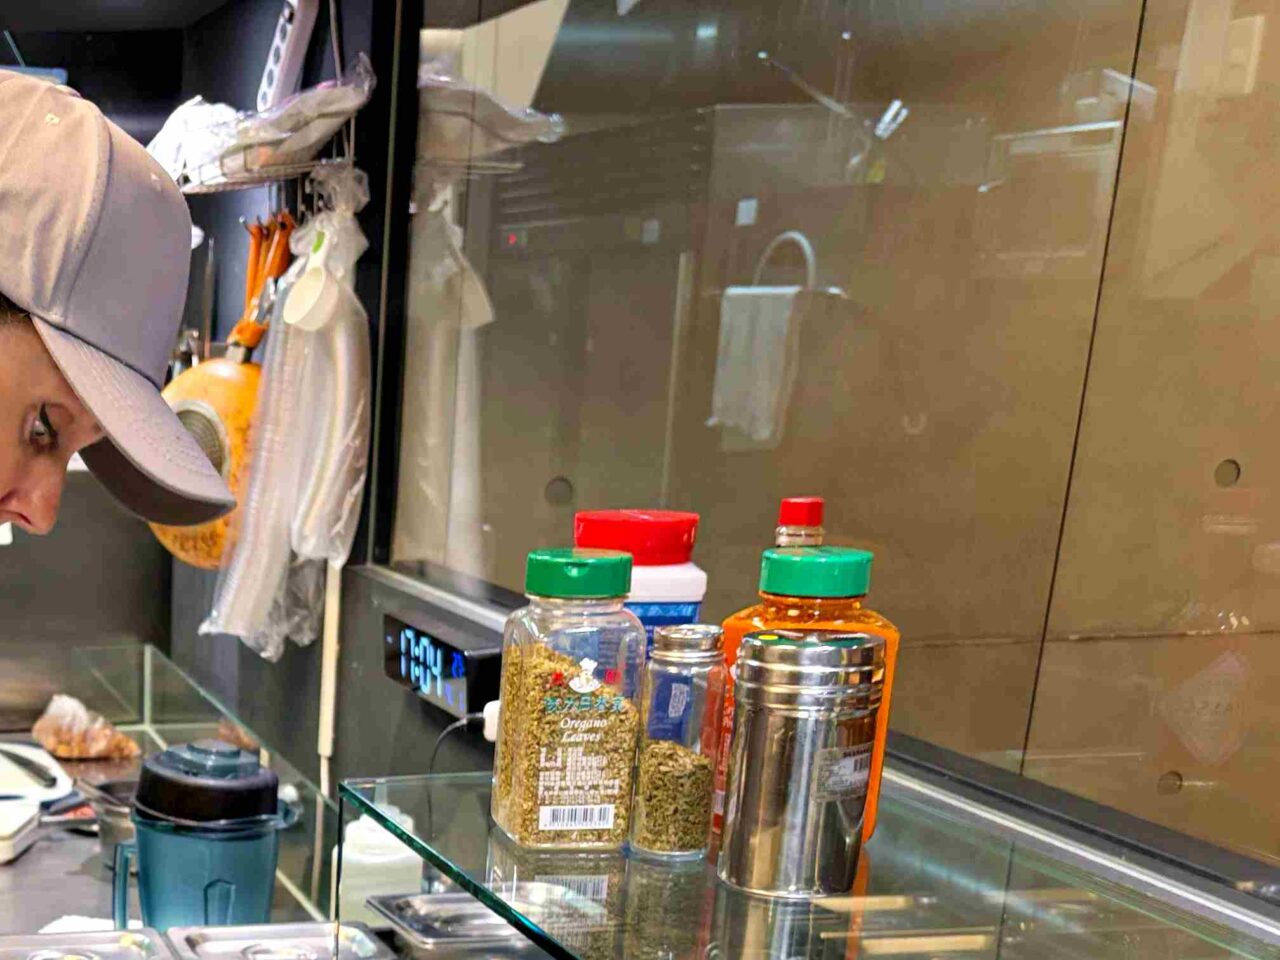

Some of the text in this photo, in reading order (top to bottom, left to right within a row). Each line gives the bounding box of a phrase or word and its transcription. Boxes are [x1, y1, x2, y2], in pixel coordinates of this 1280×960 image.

[400, 628, 442, 698] 17:04
[560, 717, 607, 731] Oregano
[562, 731, 601, 742] Leaves
